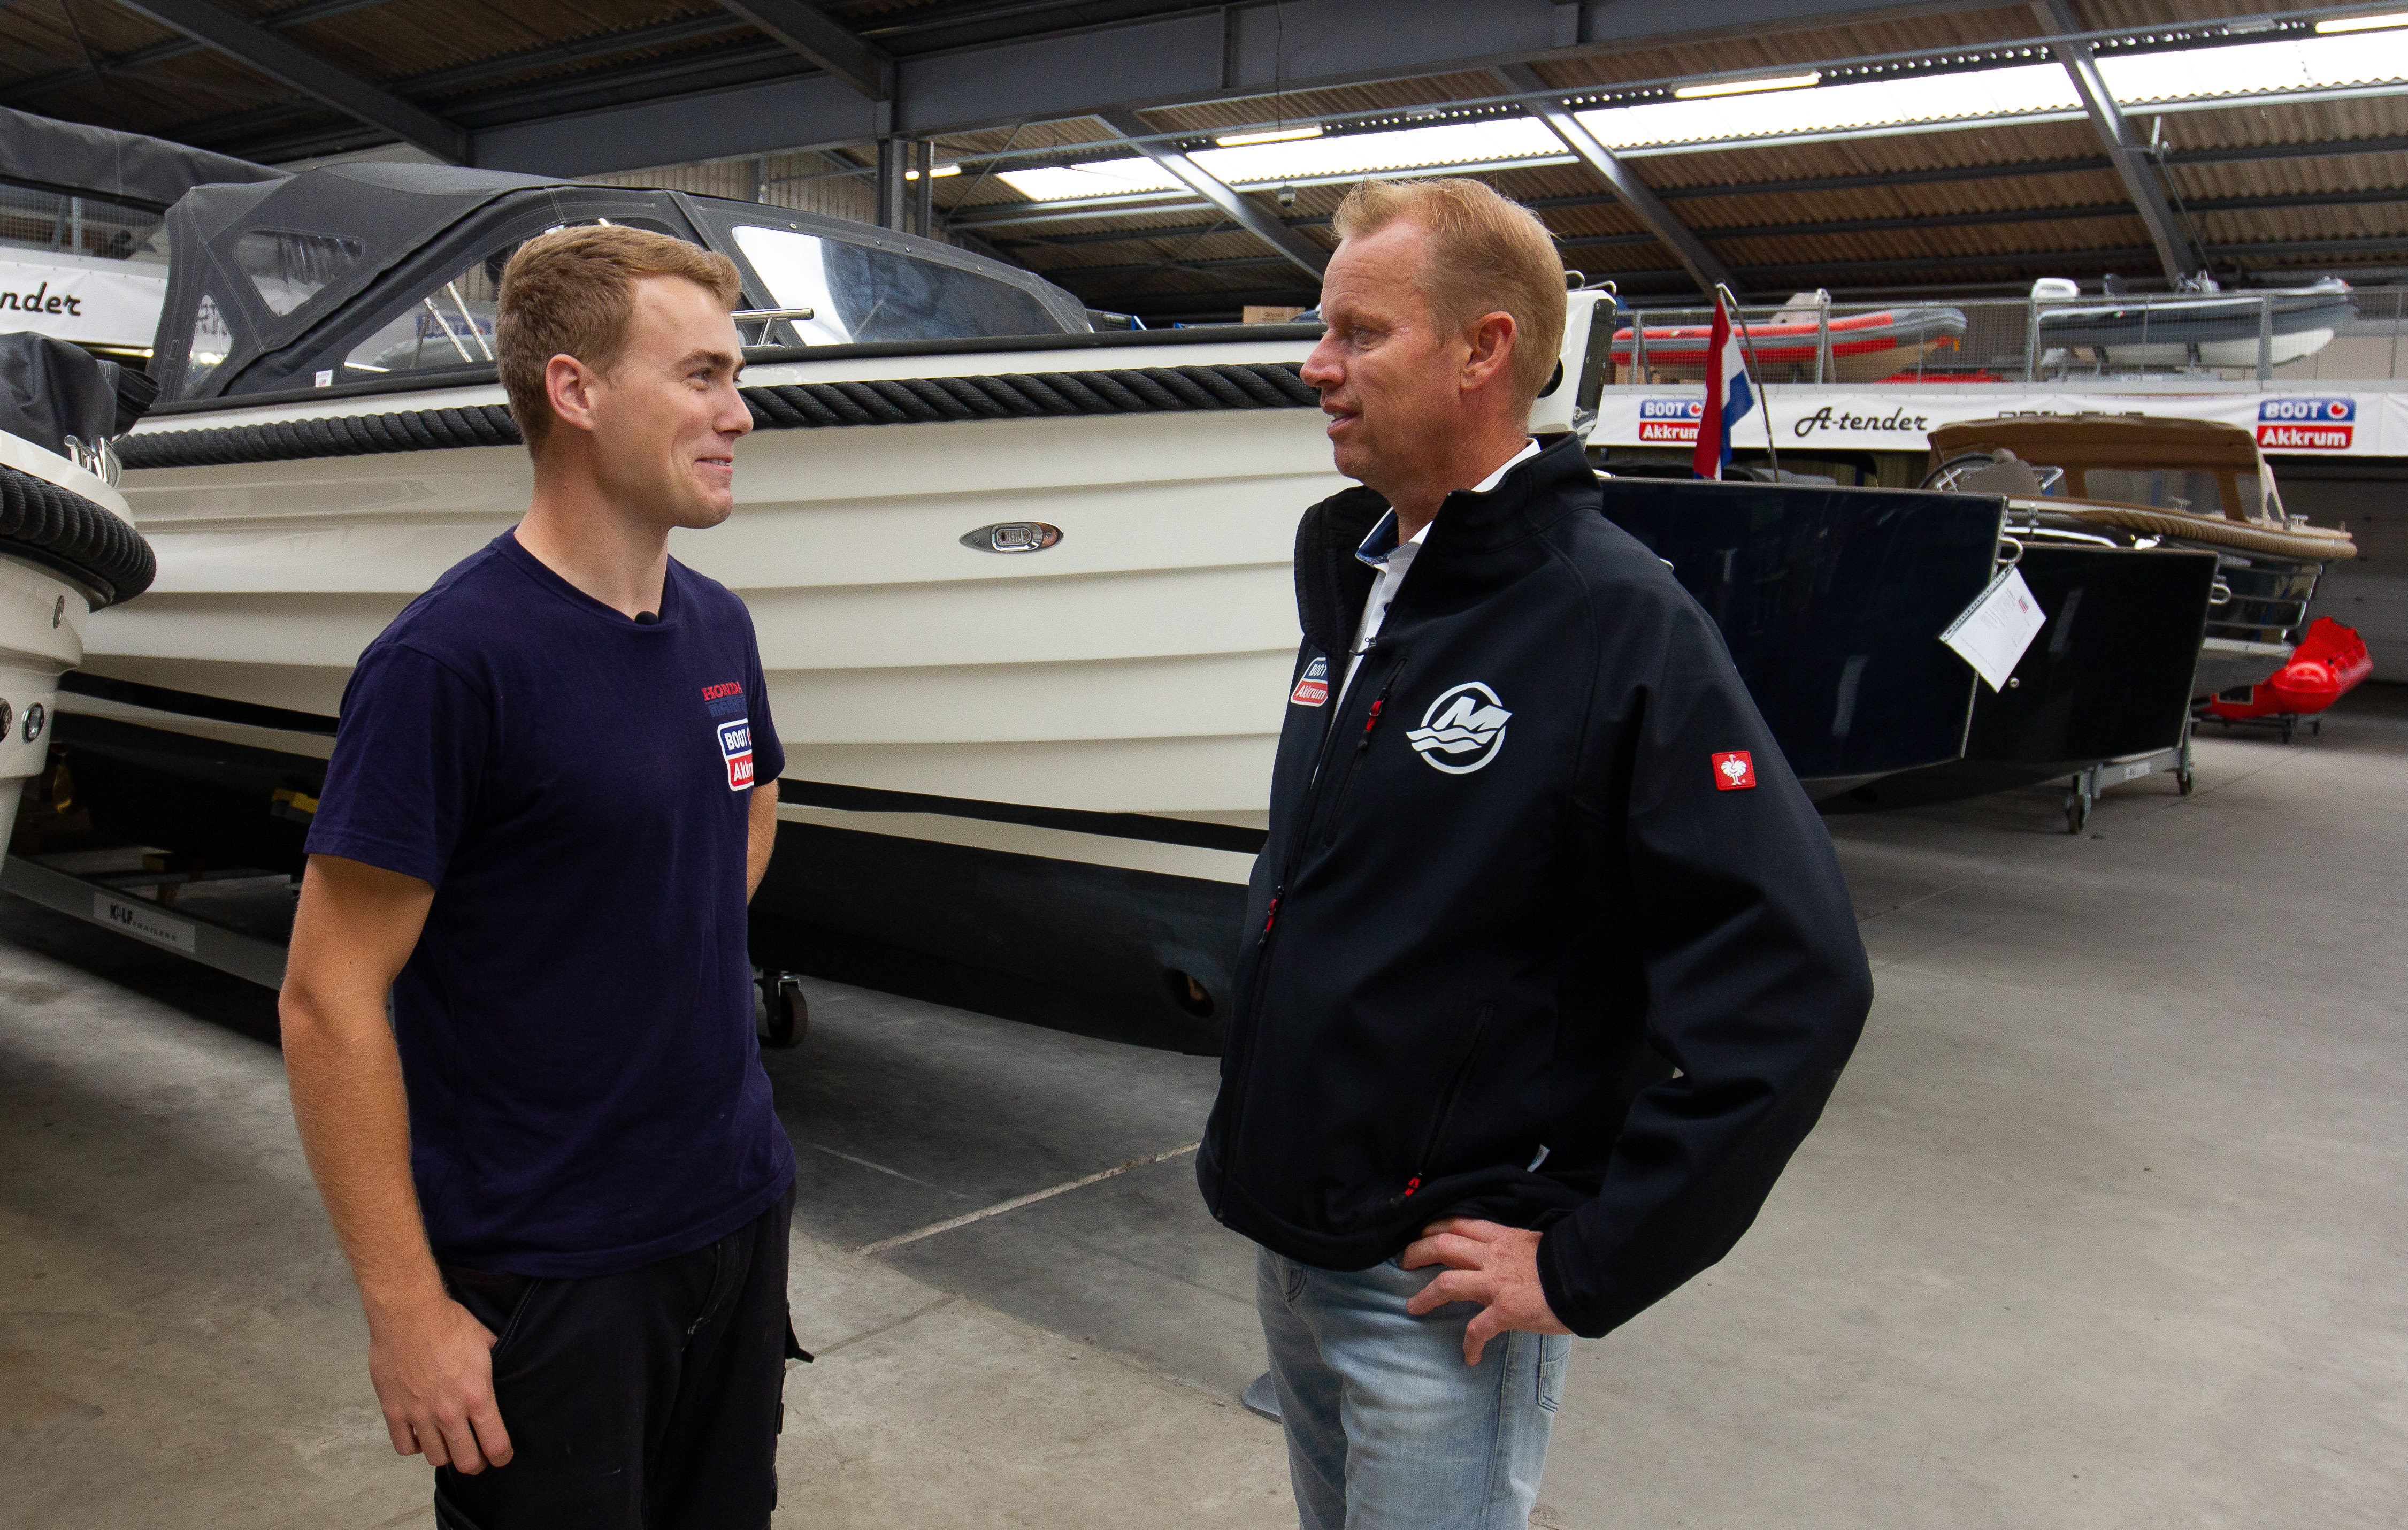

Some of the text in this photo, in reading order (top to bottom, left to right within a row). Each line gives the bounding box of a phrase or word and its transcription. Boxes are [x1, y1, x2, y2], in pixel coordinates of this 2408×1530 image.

[1645, 402, 1685, 417] BOOT
[2266, 402, 2322, 419] BOOT
[1794, 406, 1928, 437] A-tender
[2261, 428, 2347, 446] Akkrum
[701, 681, 743, 701] HONDA
[1296, 684, 1326, 700] Akkrum
[724, 729, 748, 751] BOOT
[733, 760, 754, 782] Akkr
